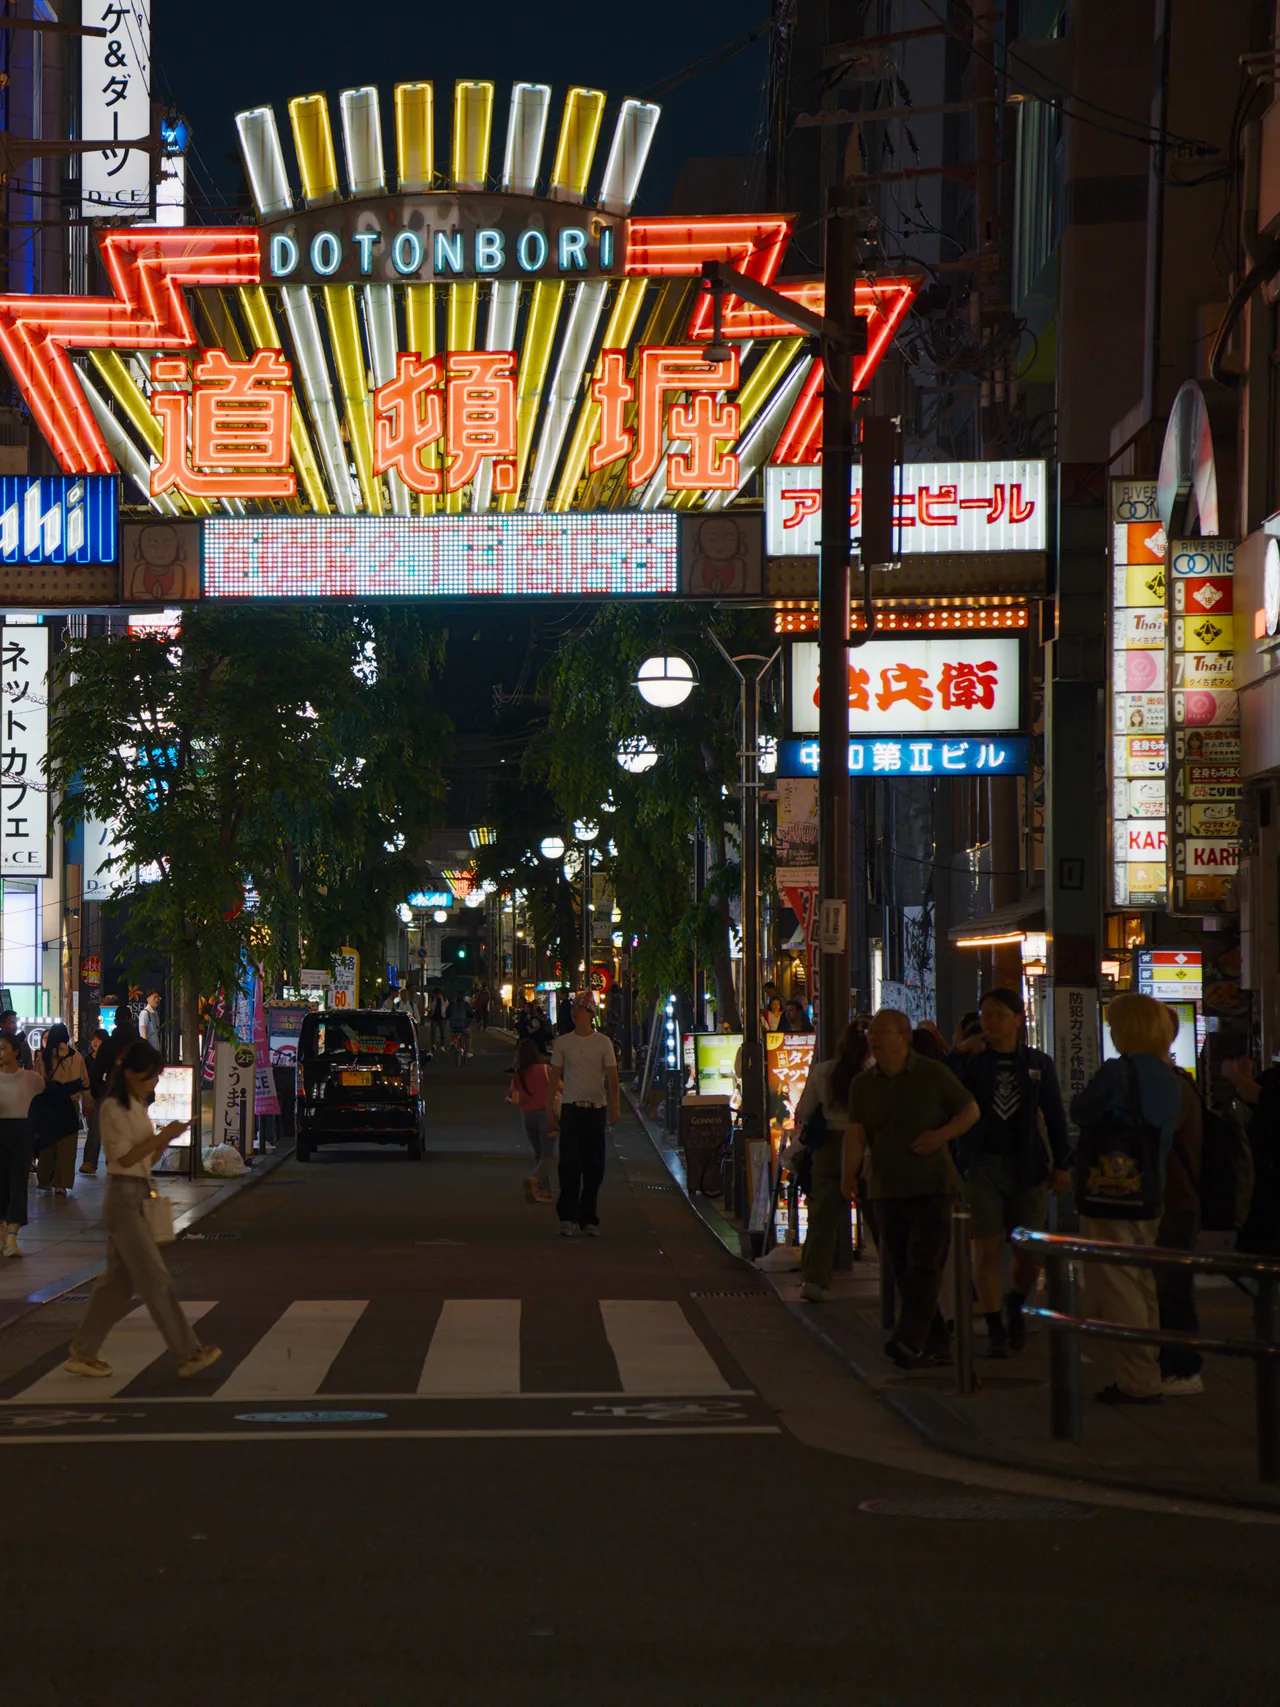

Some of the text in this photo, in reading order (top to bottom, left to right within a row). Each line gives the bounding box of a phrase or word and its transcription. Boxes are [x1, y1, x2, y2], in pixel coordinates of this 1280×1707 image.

[270, 226, 613, 279] DOTONBORI
[150, 345, 741, 497] 道頓堀
[781, 484, 1035, 529] アビール
[2, 641, 30, 838] ネットカフェ
[335, 991, 347, 1008] 60
[237, 1054, 253, 1064] 2F
[1069, 992, 1085, 1095] 防犯カメラ作動中
[691, 1116, 723, 1125] GUINNESS
